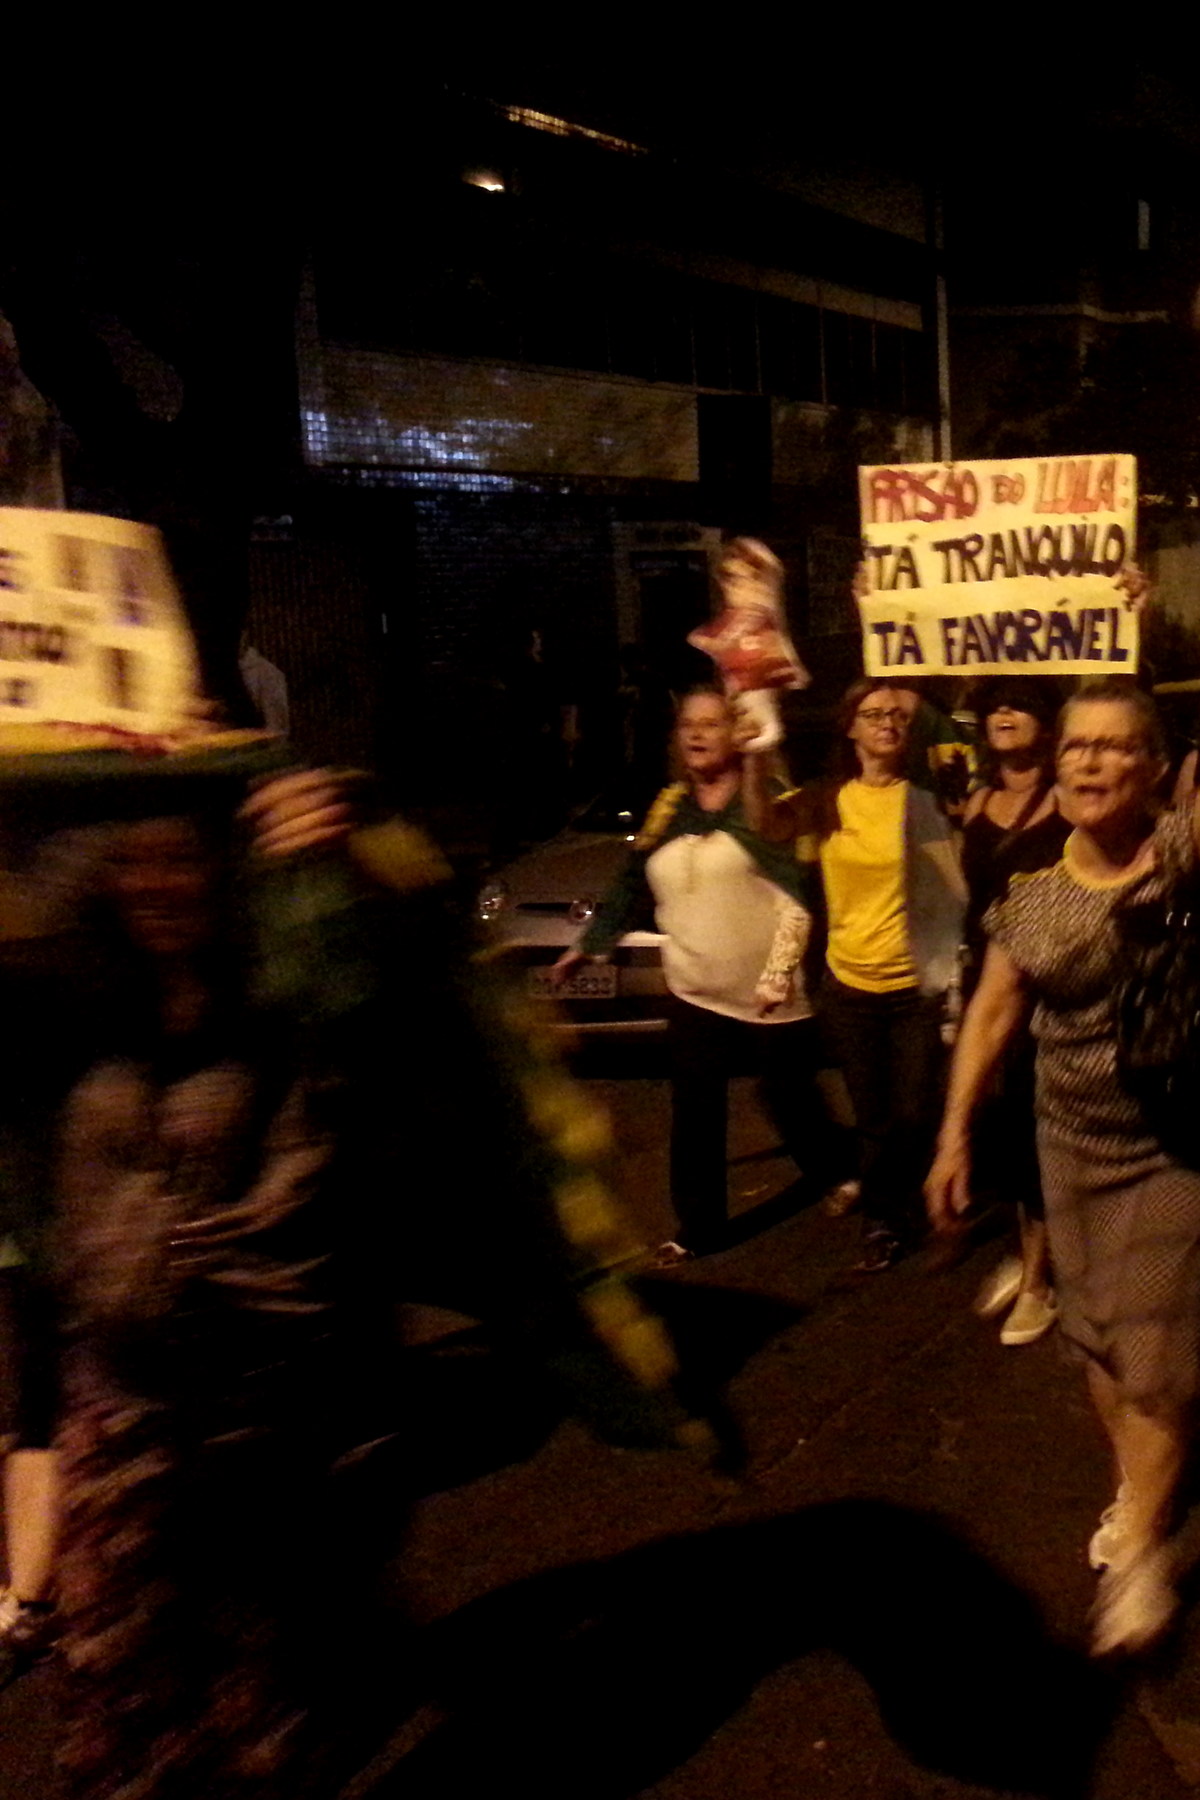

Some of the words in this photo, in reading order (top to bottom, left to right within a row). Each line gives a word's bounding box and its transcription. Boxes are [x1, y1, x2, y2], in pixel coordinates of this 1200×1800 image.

[864, 533, 922, 590] TÁ
[868, 612, 925, 666] TÁ
[939, 597, 1129, 666] FAVORÁVEL
